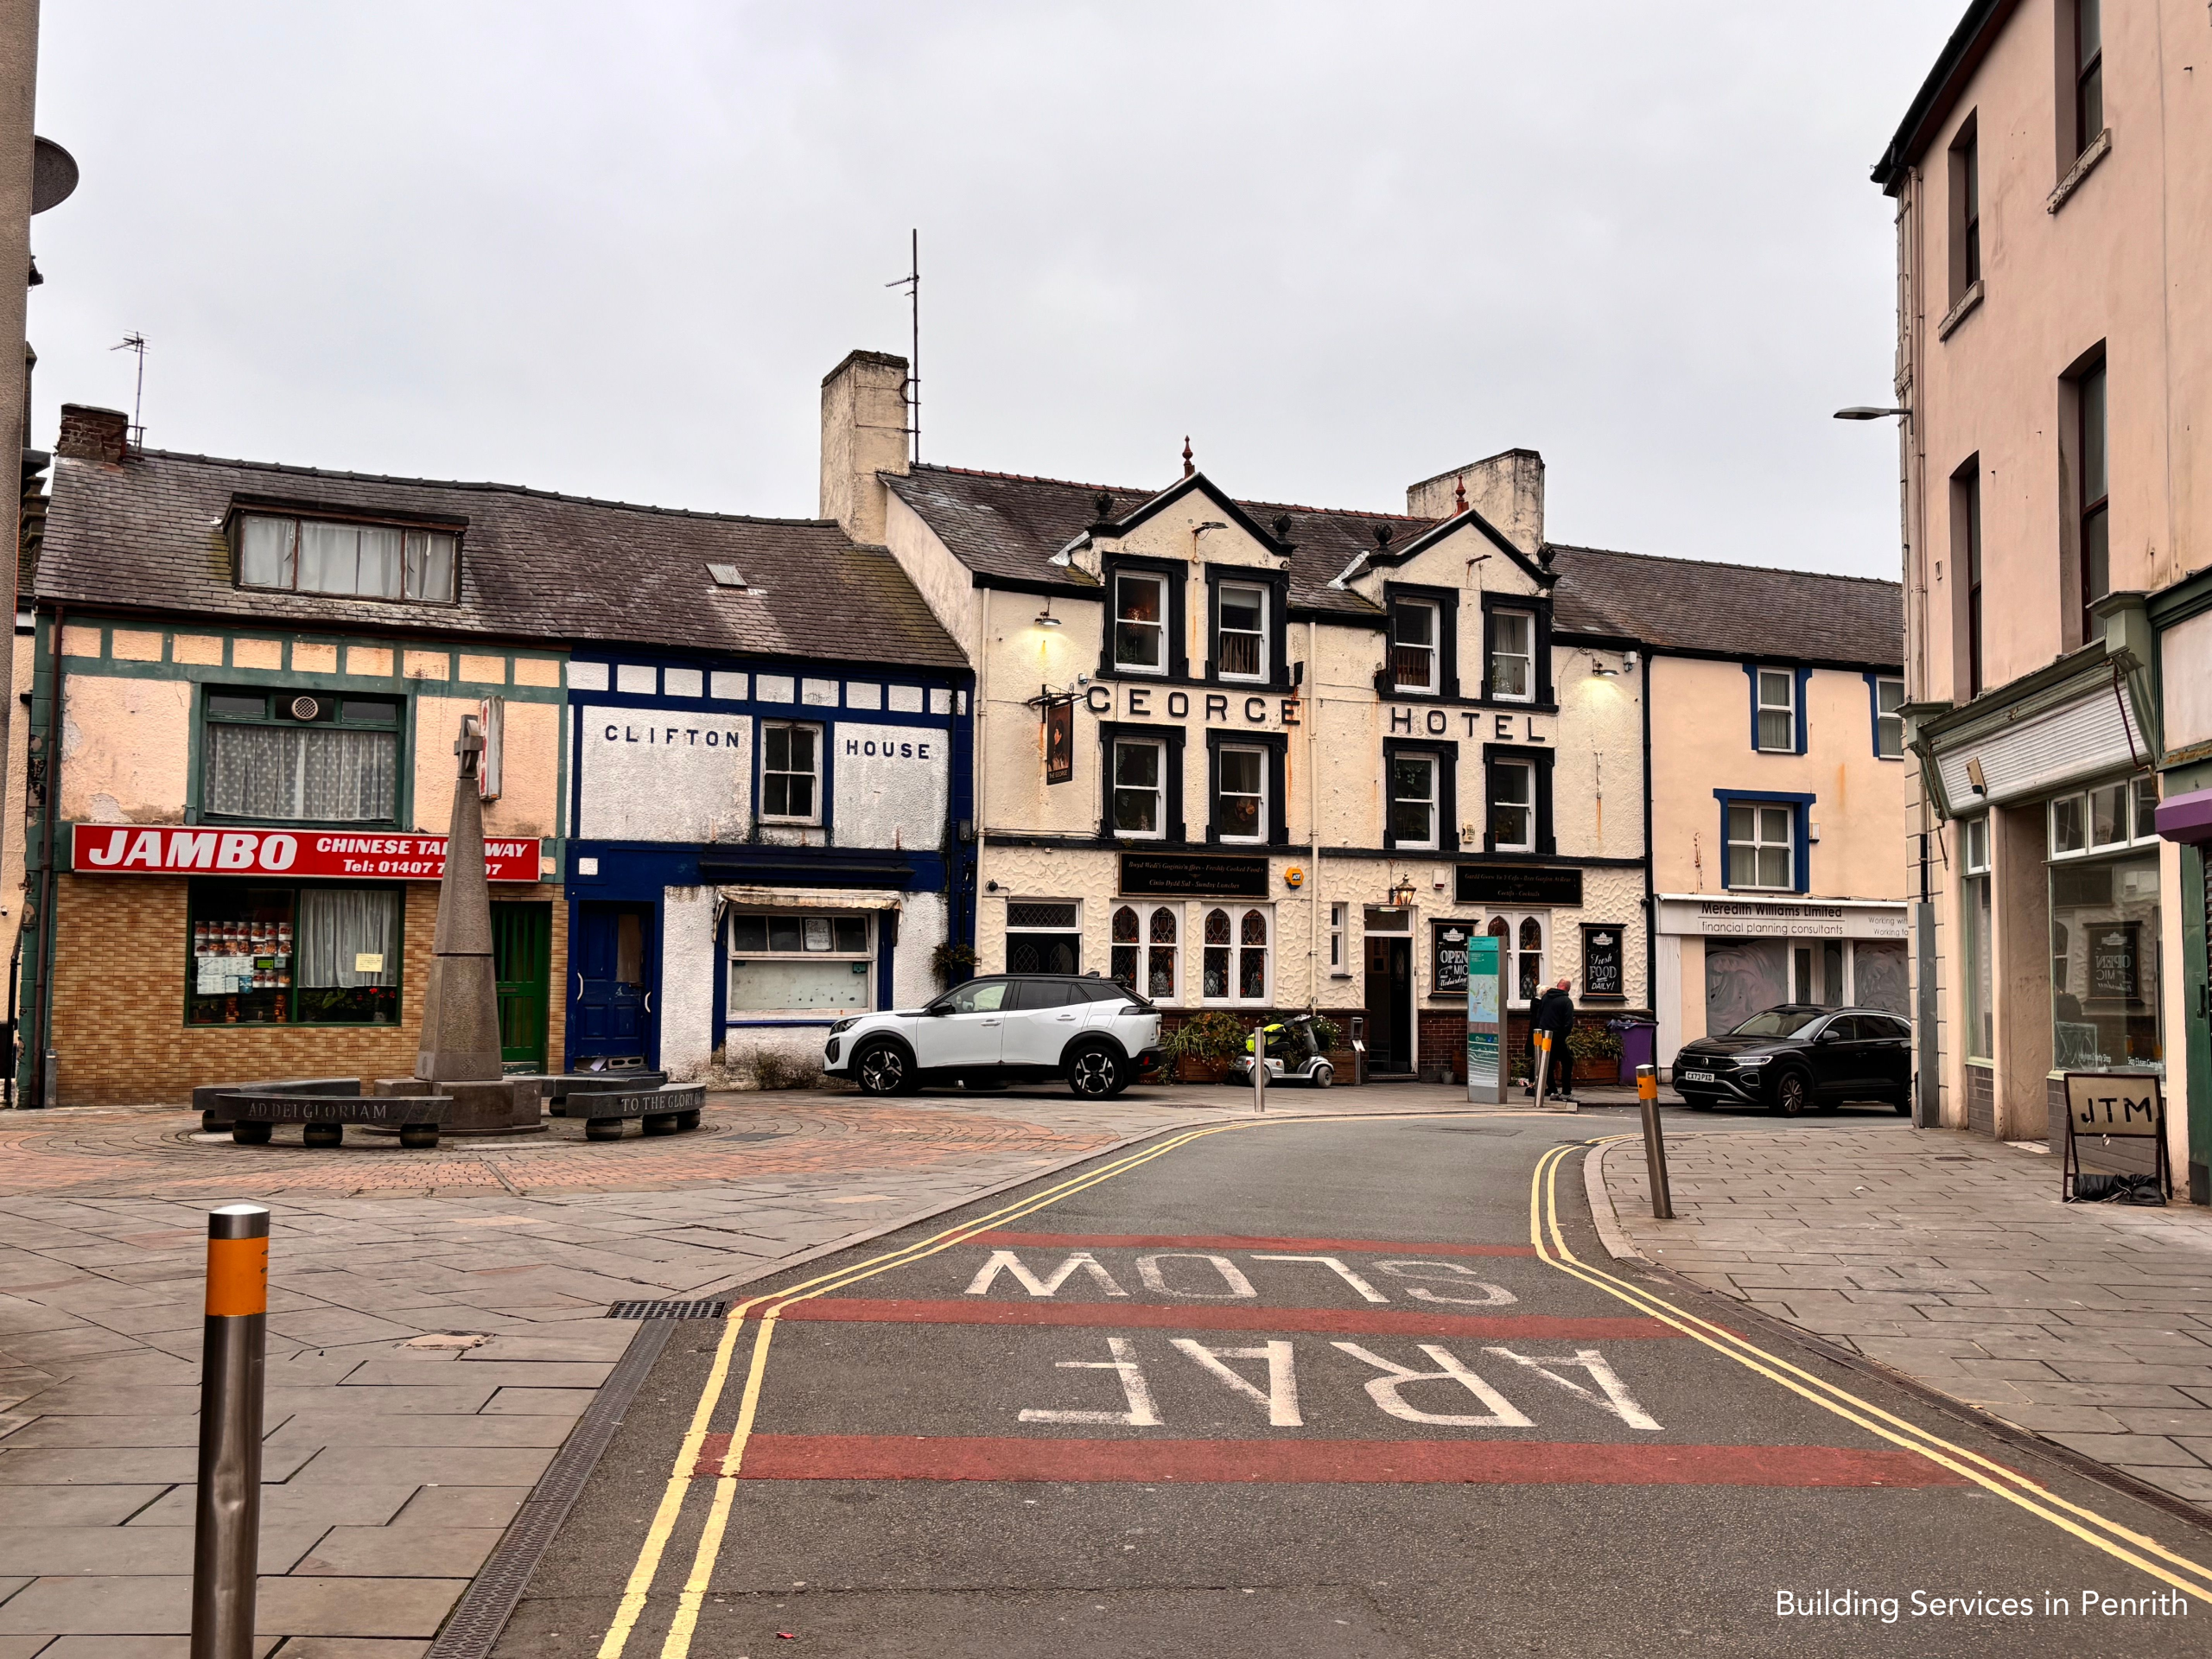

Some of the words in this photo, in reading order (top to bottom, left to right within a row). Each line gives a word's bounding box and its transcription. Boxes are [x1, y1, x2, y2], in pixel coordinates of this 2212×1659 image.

[1086, 686, 1300, 725] GEORGE
[1390, 707, 1546, 741] HOTEL
[605, 725, 739, 747] CLIFTON
[847, 740, 930, 759] HOUSE
[88, 830, 298, 870] JAMBO
[316, 837, 410, 855] CHINESE
[416, 841, 528, 857] TAWAY
[343, 860, 374, 873] Tel:
[378, 861, 434, 874] 01407
[1701, 903, 1751, 915] Meredith
[1755, 904, 1800, 917] Williams
[1804, 905, 1842, 918] Limited
[1702, 921, 1744, 933] financial
[1747, 922, 1788, 935] planning
[1791, 925, 1843, 935] consultants
[1868, 917, 1895, 926] Working
[1873, 928, 1900, 937] Working
[1440, 950, 1468, 963] OPEN
[1591, 953, 1612, 965] Fresh
[1453, 964, 1468, 975] MIC
[1589, 965, 1617, 980] FOOD
[1591, 982, 1615, 991] DAILY!
[621, 1098, 639, 1112] TO
[643, 1096, 665, 1109] THE
[668, 1092, 694, 1109] GLORY
[2081, 1096, 2152, 1123] JTM
[248, 1103, 267, 1116] AD
[272, 1103, 297, 1118] DEI
[303, 1103, 387, 1119] GLORIAM
[963, 1250, 1518, 1306] SLOW
[1018, 1337, 1665, 1431] ARAF
